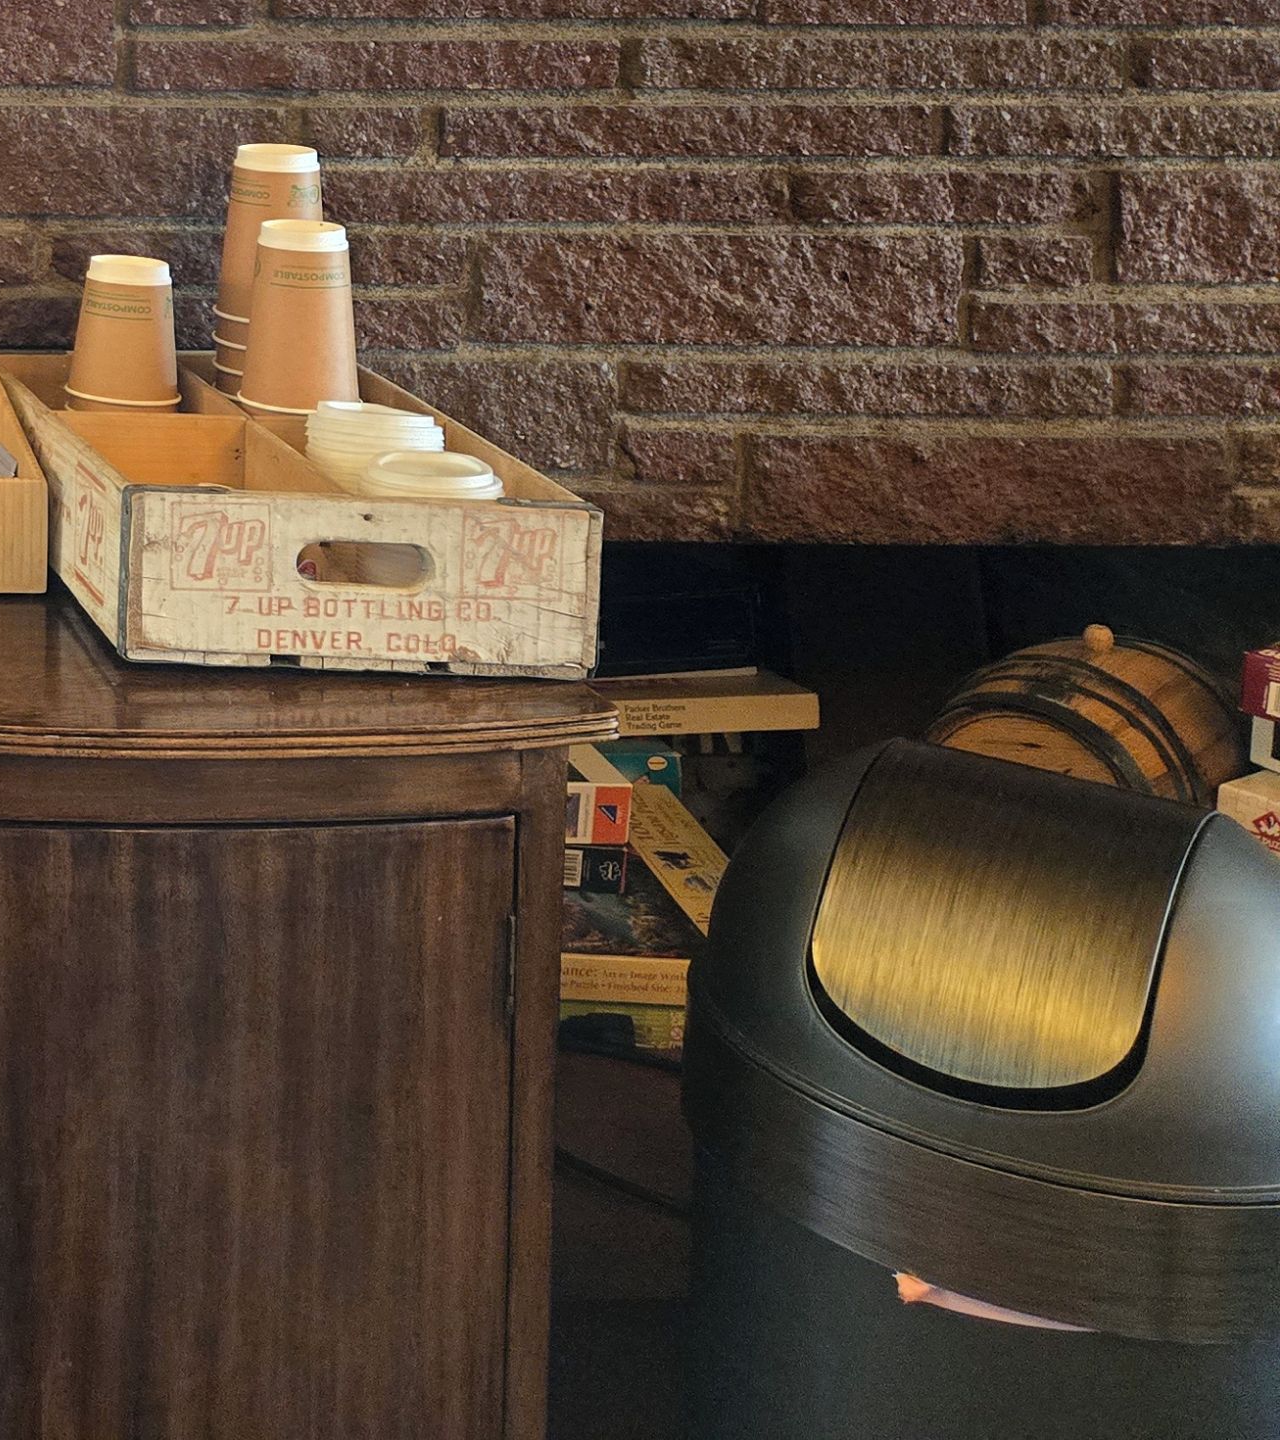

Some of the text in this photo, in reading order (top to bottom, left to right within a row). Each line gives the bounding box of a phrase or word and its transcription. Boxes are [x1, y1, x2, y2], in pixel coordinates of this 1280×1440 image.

[272, 269, 346, 283] COMPOSTABLE
[303, 595, 442, 622] BOTTLING
[652, 703, 686, 712] Brothers
[625, 713, 671, 721] Real Estate
[626, 721, 682, 731] Trading Game
